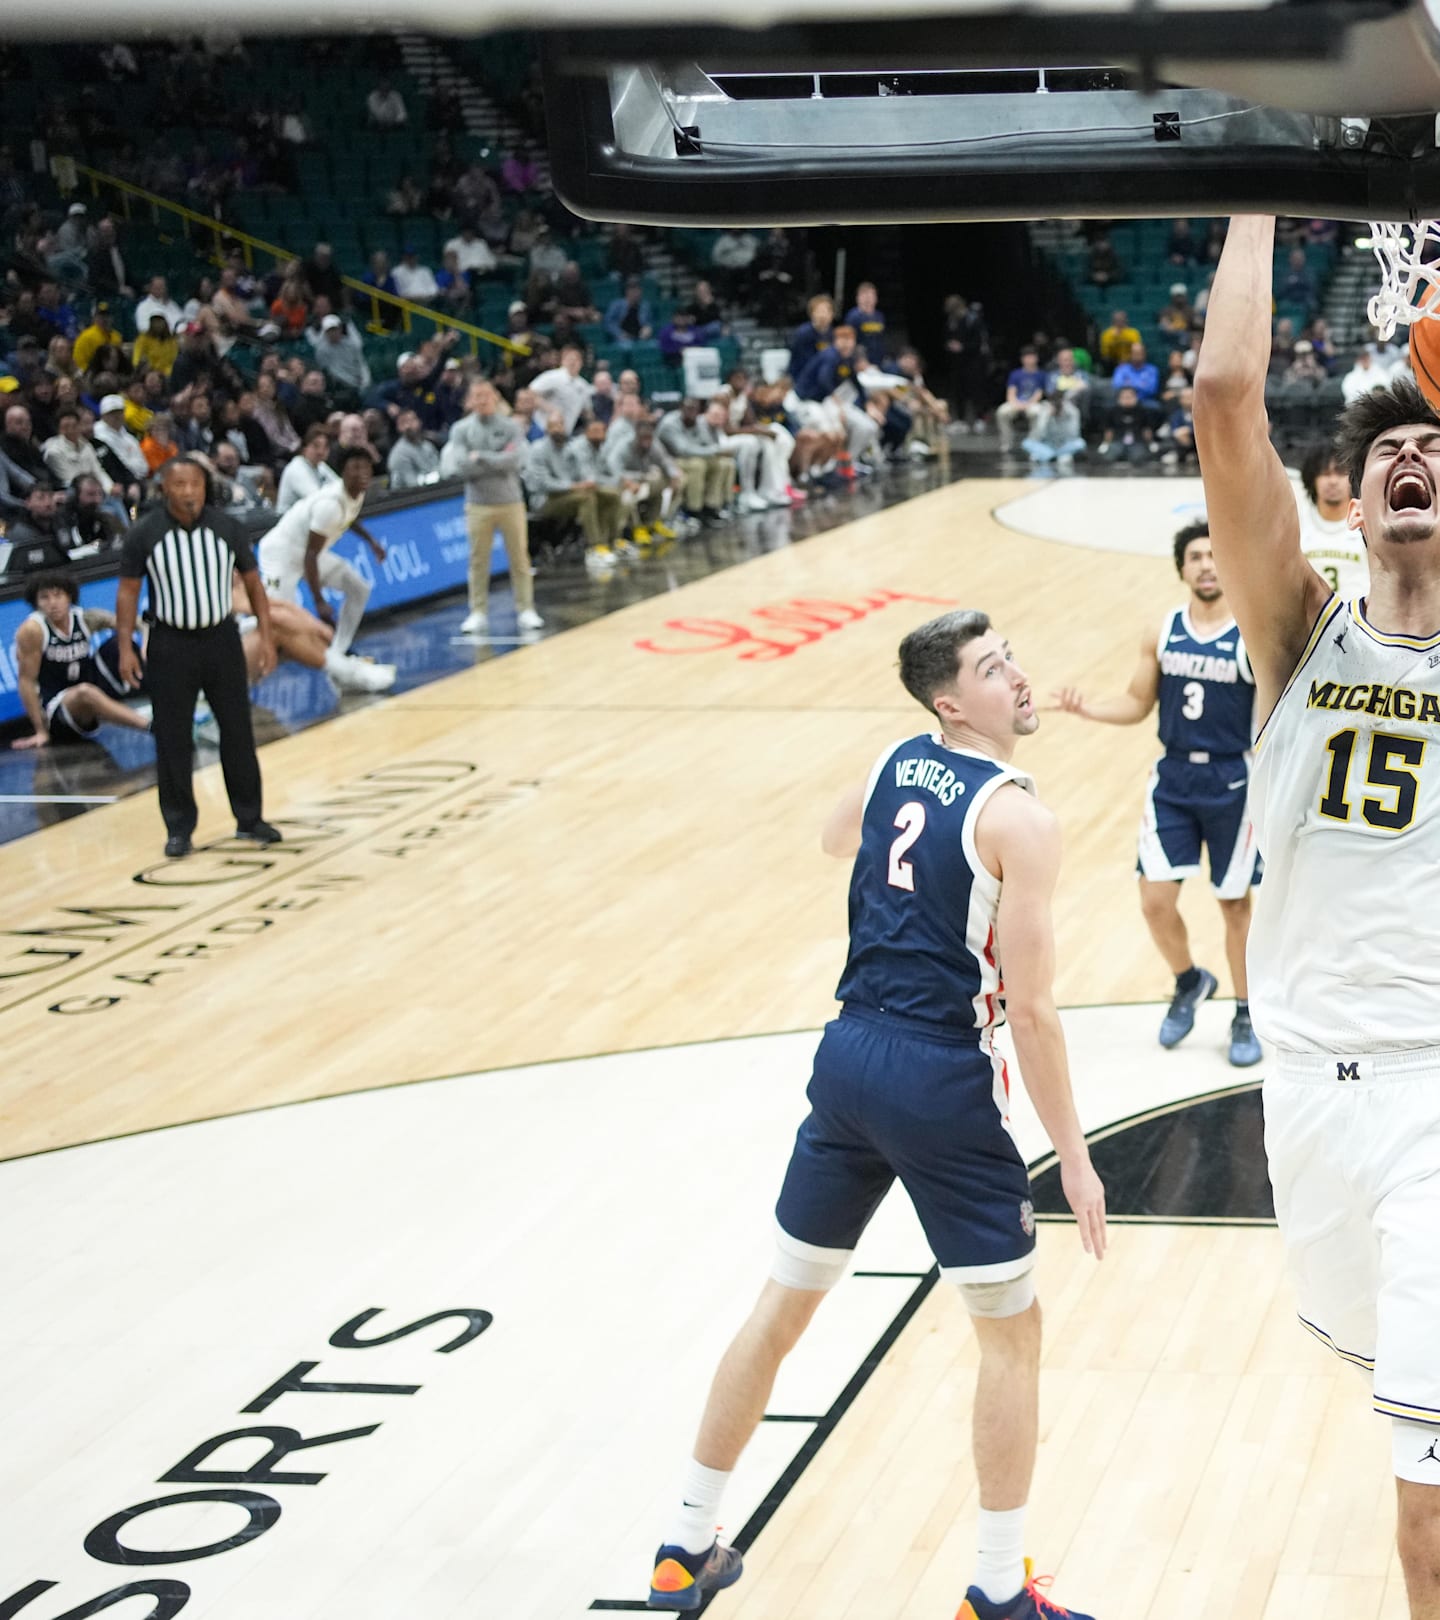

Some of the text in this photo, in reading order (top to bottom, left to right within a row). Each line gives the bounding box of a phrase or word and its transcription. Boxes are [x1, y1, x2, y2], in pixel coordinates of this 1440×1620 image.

[1324, 566, 1339, 592] 3
[1161, 650, 1238, 684] GONZAGA
[1182, 681, 1205, 720] 3
[895, 758, 966, 806] VENTERS
[1318, 727, 1428, 832] 15
[887, 801, 926, 892] 2
[1336, 1061, 1361, 1081] M
